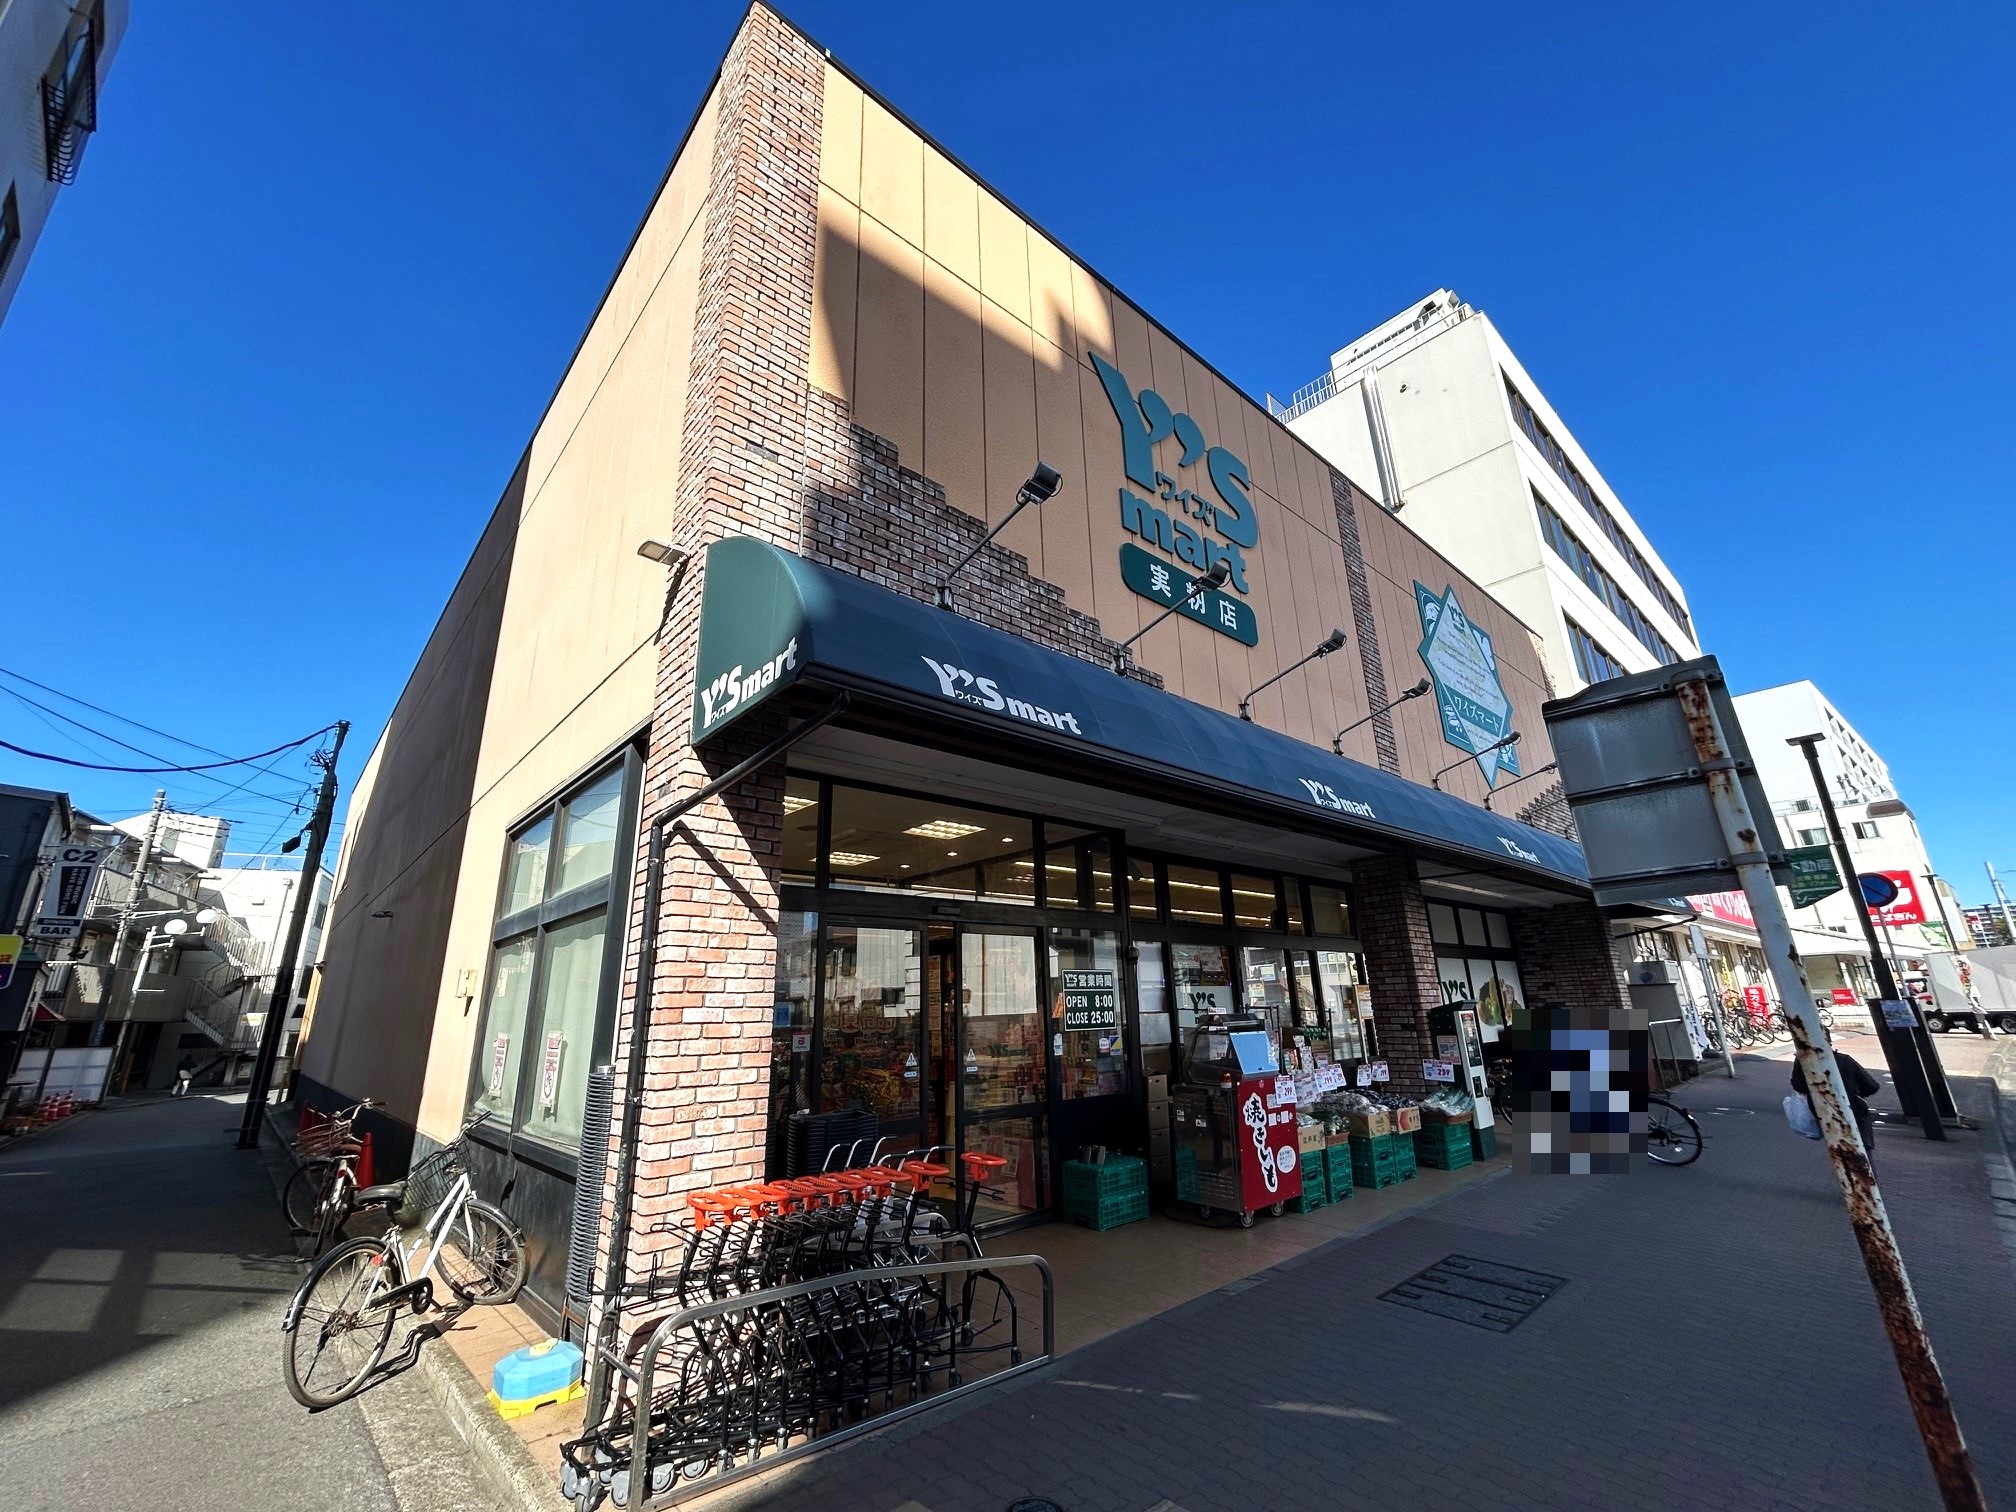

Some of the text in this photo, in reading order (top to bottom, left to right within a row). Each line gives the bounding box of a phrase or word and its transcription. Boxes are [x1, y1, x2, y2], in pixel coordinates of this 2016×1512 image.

[1155, 471, 1214, 526] ワイズ
[1119, 487, 1249, 594] mart
[740, 637, 797, 703] mart
[955, 690, 982, 705] ワイズ
[711, 705, 726, 723] ワイズ
[1005, 697, 1082, 735] mart
[1454, 697, 1500, 731] ワイズマート
[1341, 799, 1376, 819] mart
[63, 849, 98, 864] C2
[39, 926, 71, 935] BAR
[1078, 974, 1112, 987] 営業時間
[1066, 995, 1113, 1008] OPEN 8:00
[1066, 1011, 1114, 1025] CLOSE 25:00
[1245, 1097, 1276, 1187] 焼きいも
